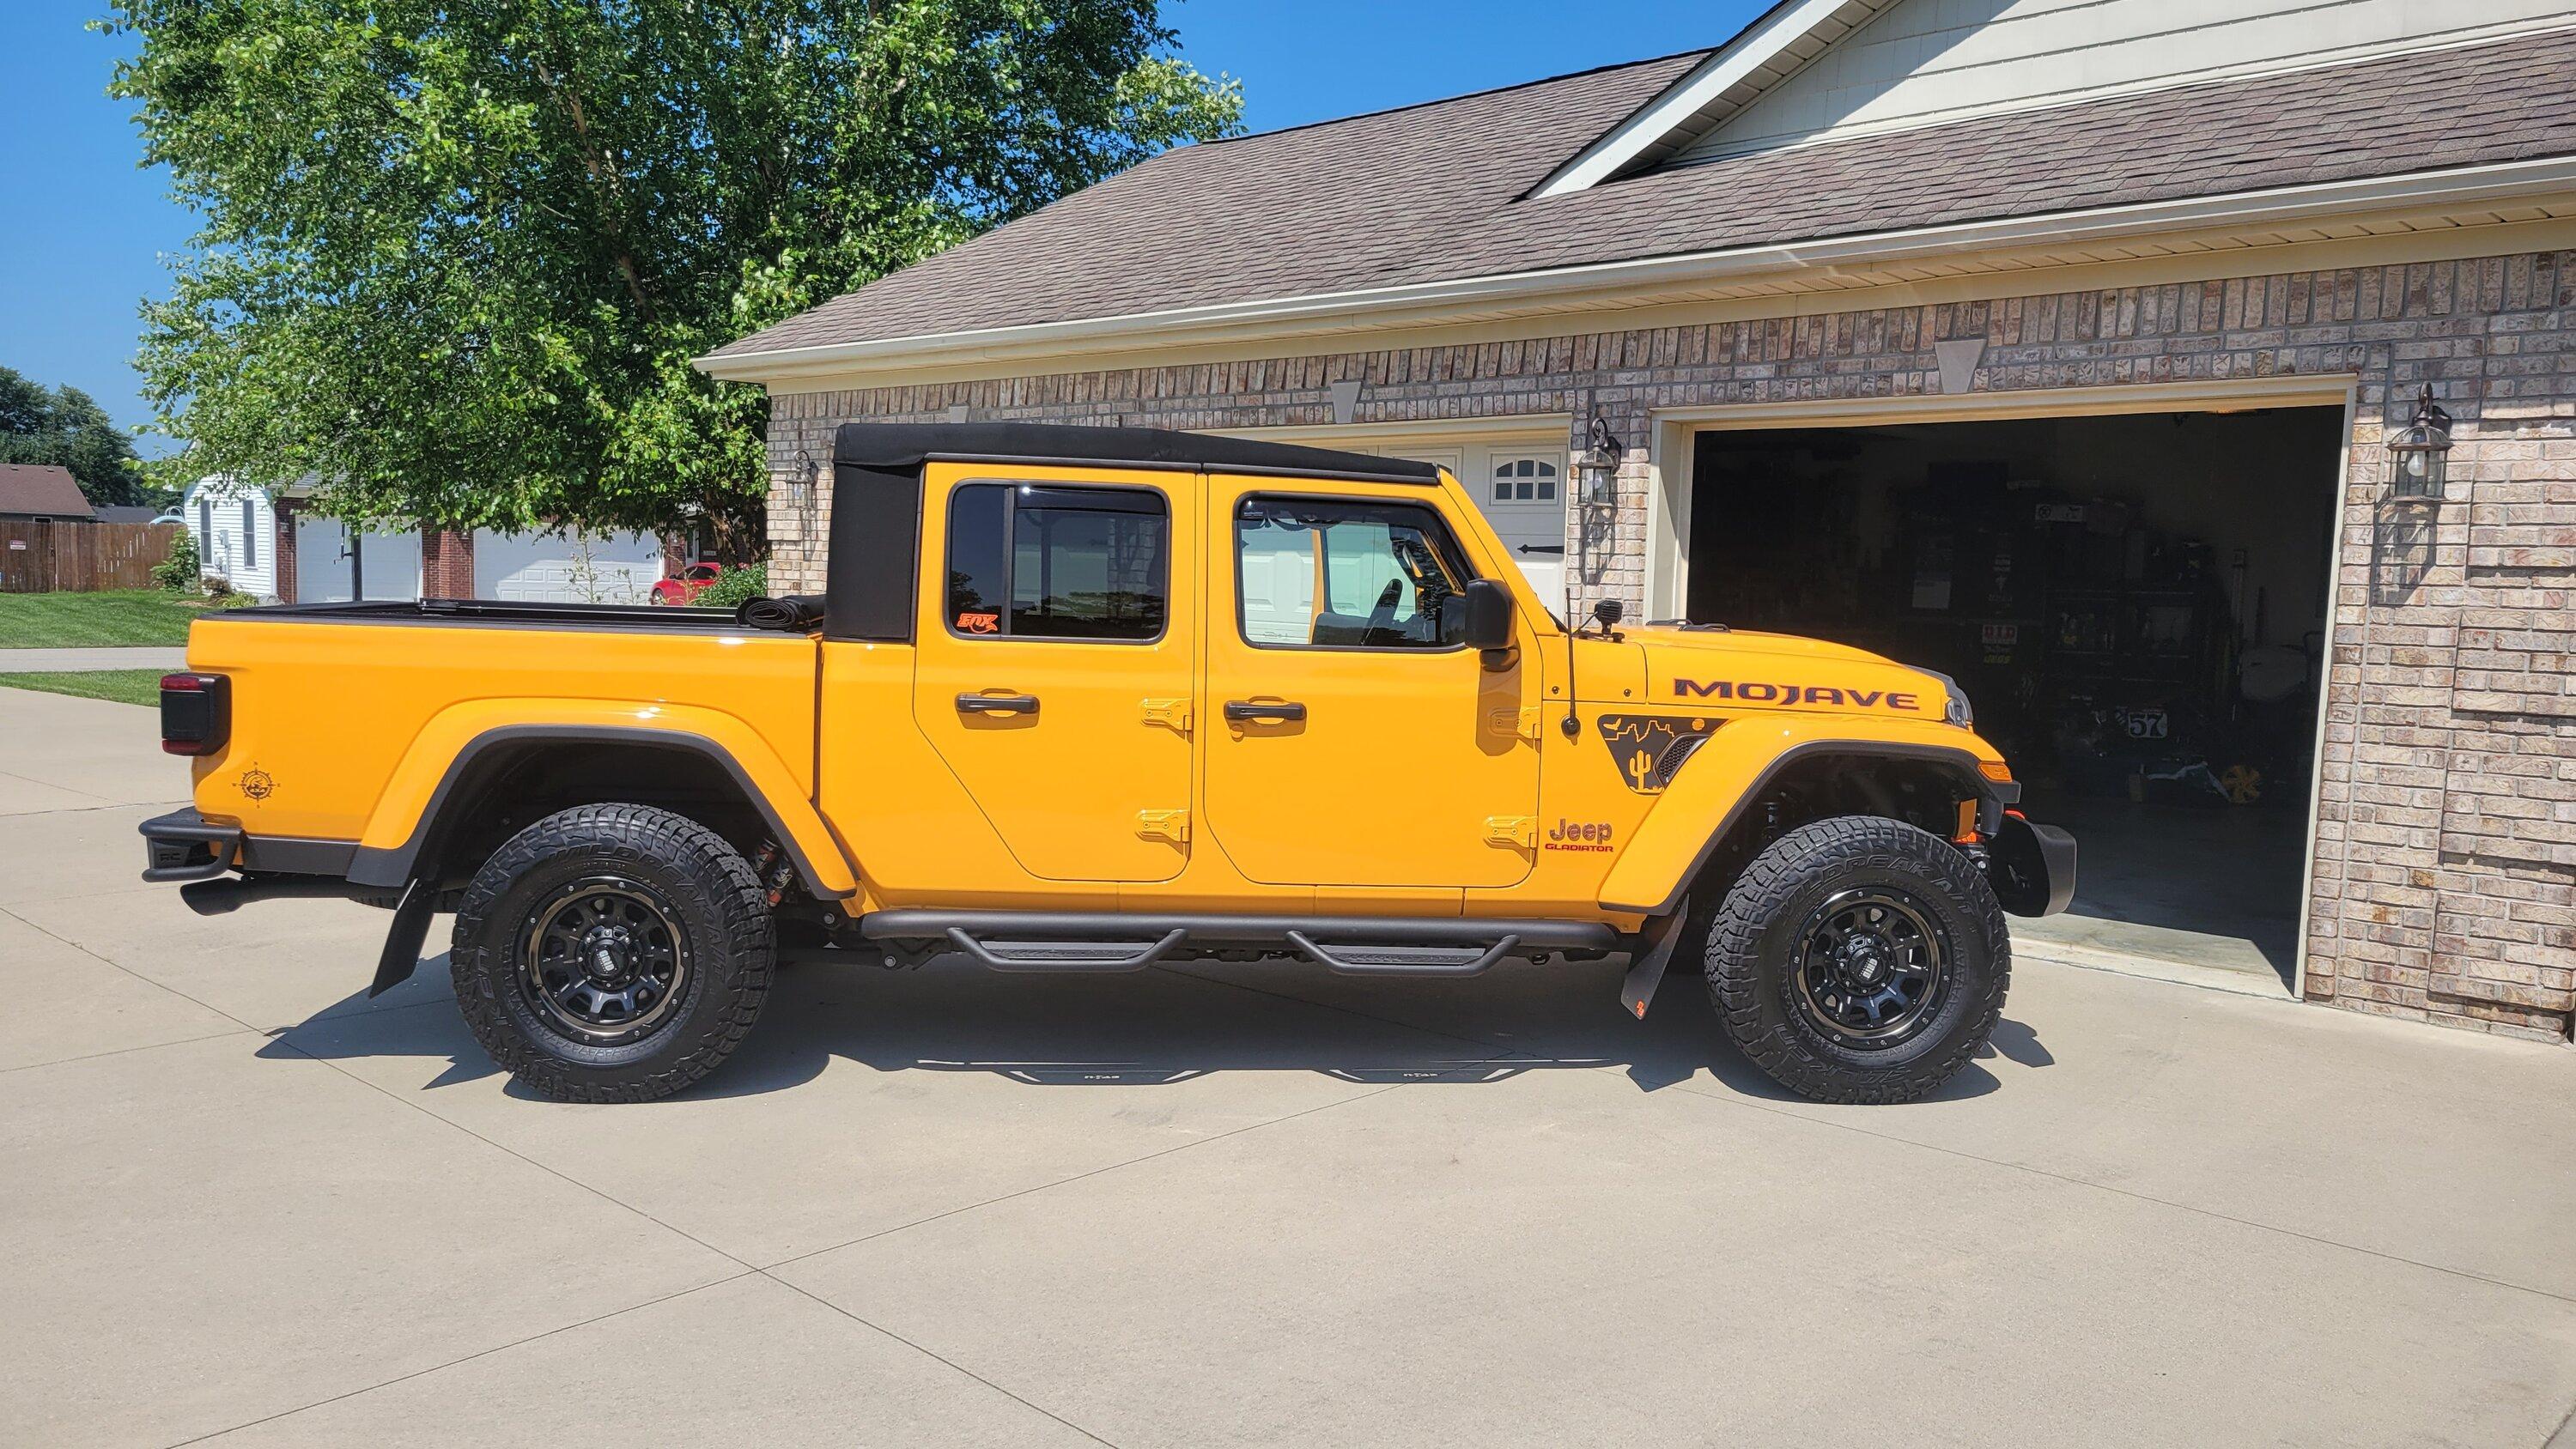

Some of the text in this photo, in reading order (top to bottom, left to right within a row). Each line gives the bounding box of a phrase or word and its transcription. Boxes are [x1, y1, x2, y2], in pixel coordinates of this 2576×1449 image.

[957, 613, 998, 634] FOX
[1674, 677, 1920, 712] MOJAVE
[2129, 712, 2164, 737] 57
[1549, 818, 1613, 845] Jeep
[1545, 843, 1614, 852] GLADIATOR
